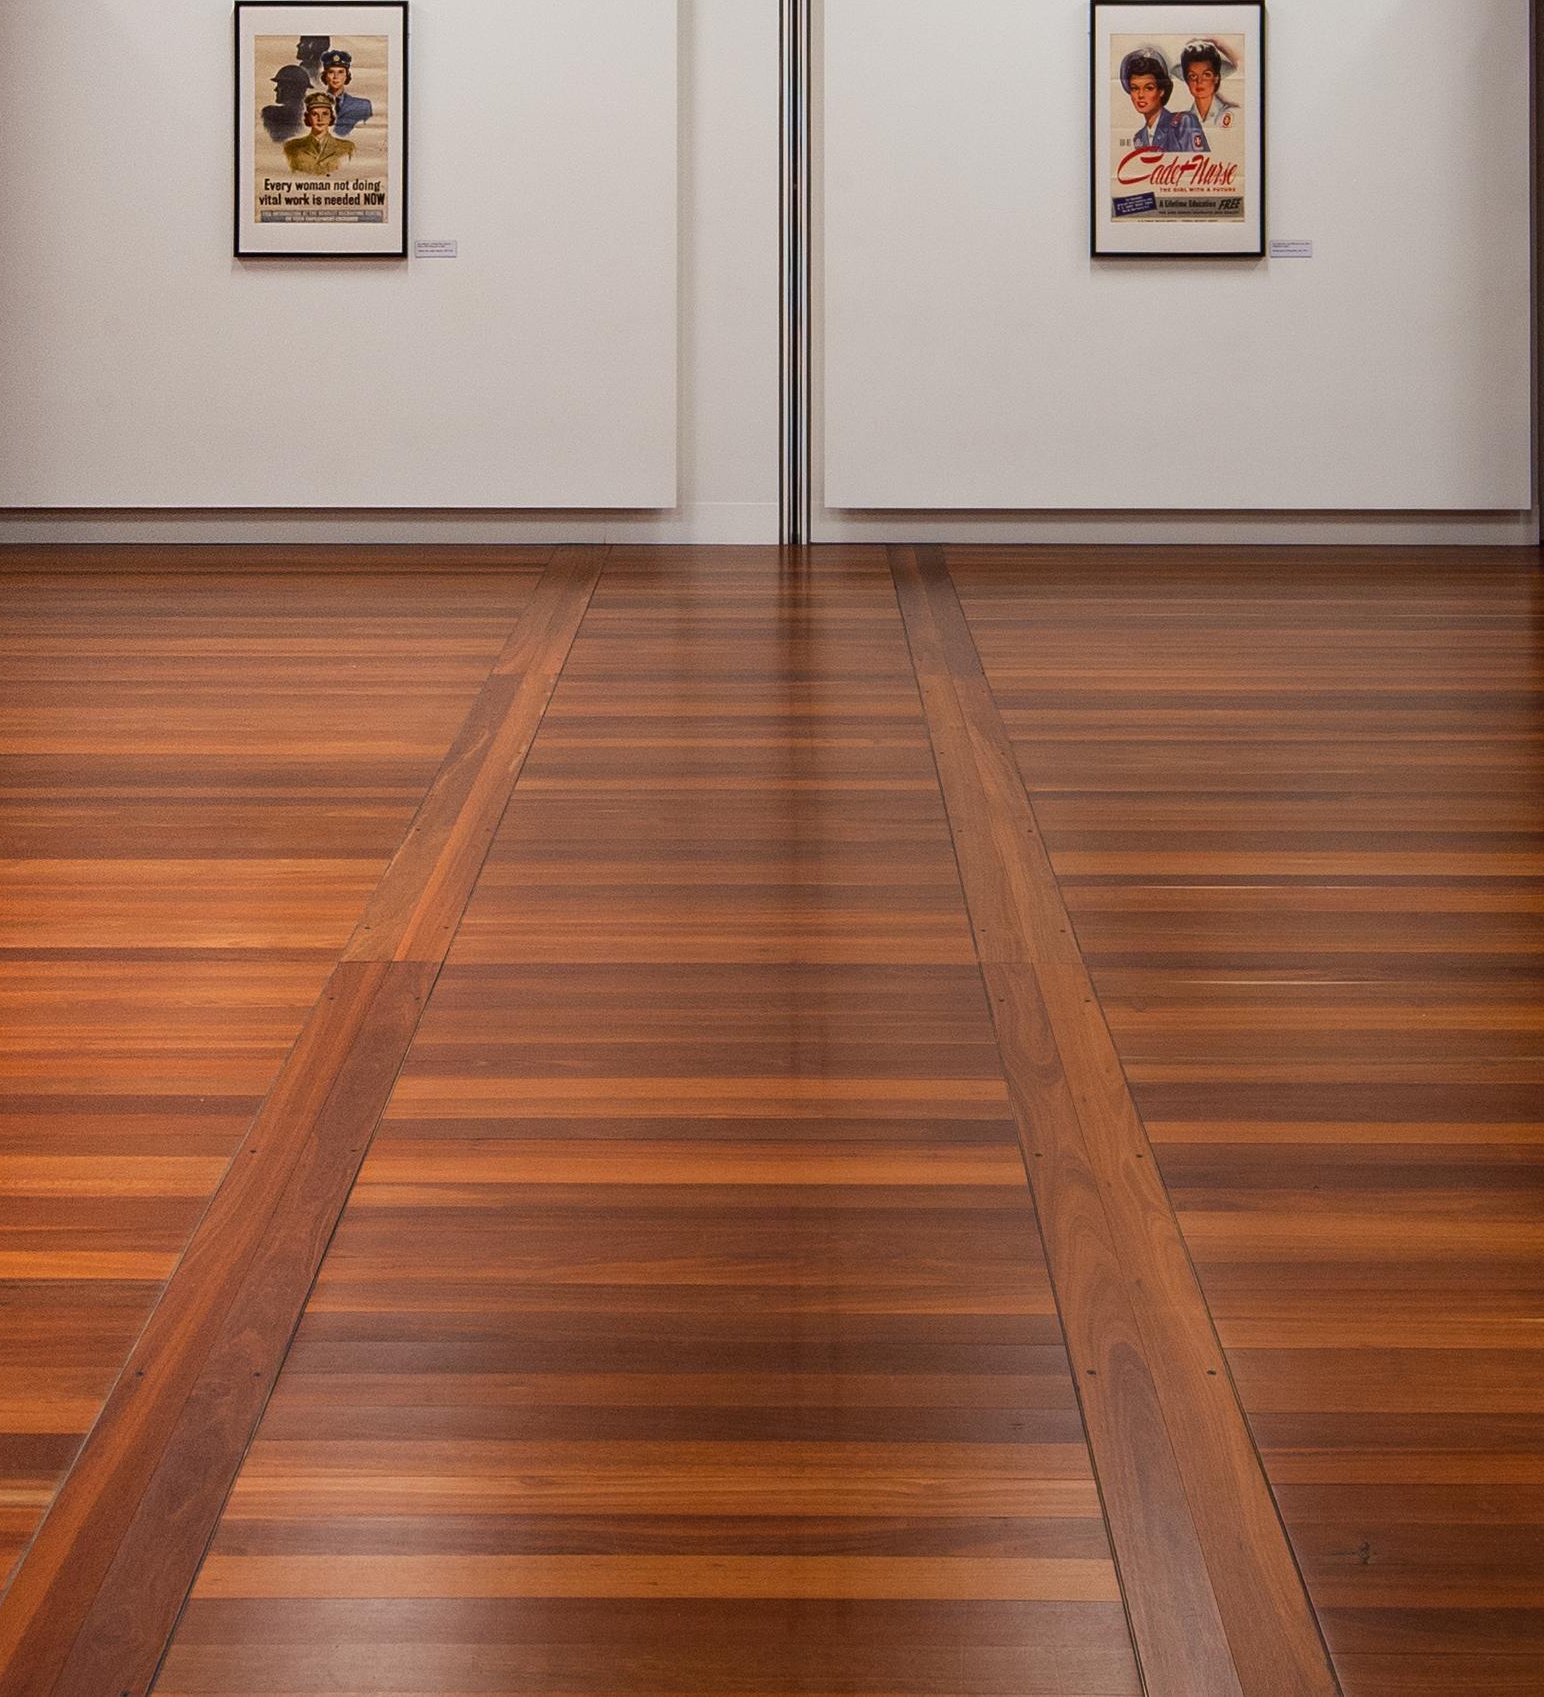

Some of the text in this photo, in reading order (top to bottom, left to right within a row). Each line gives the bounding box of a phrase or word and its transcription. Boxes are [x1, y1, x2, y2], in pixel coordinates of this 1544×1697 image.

[1116, 145, 1238, 187] Cadet Nurse
[264, 178, 381, 193] Every woman not doing
[259, 193, 386, 205] vital work is needed NOW
[1159, 200, 1164, 208] A
[1188, 199, 1216, 208] Education
[1217, 198, 1241, 211] FREE
